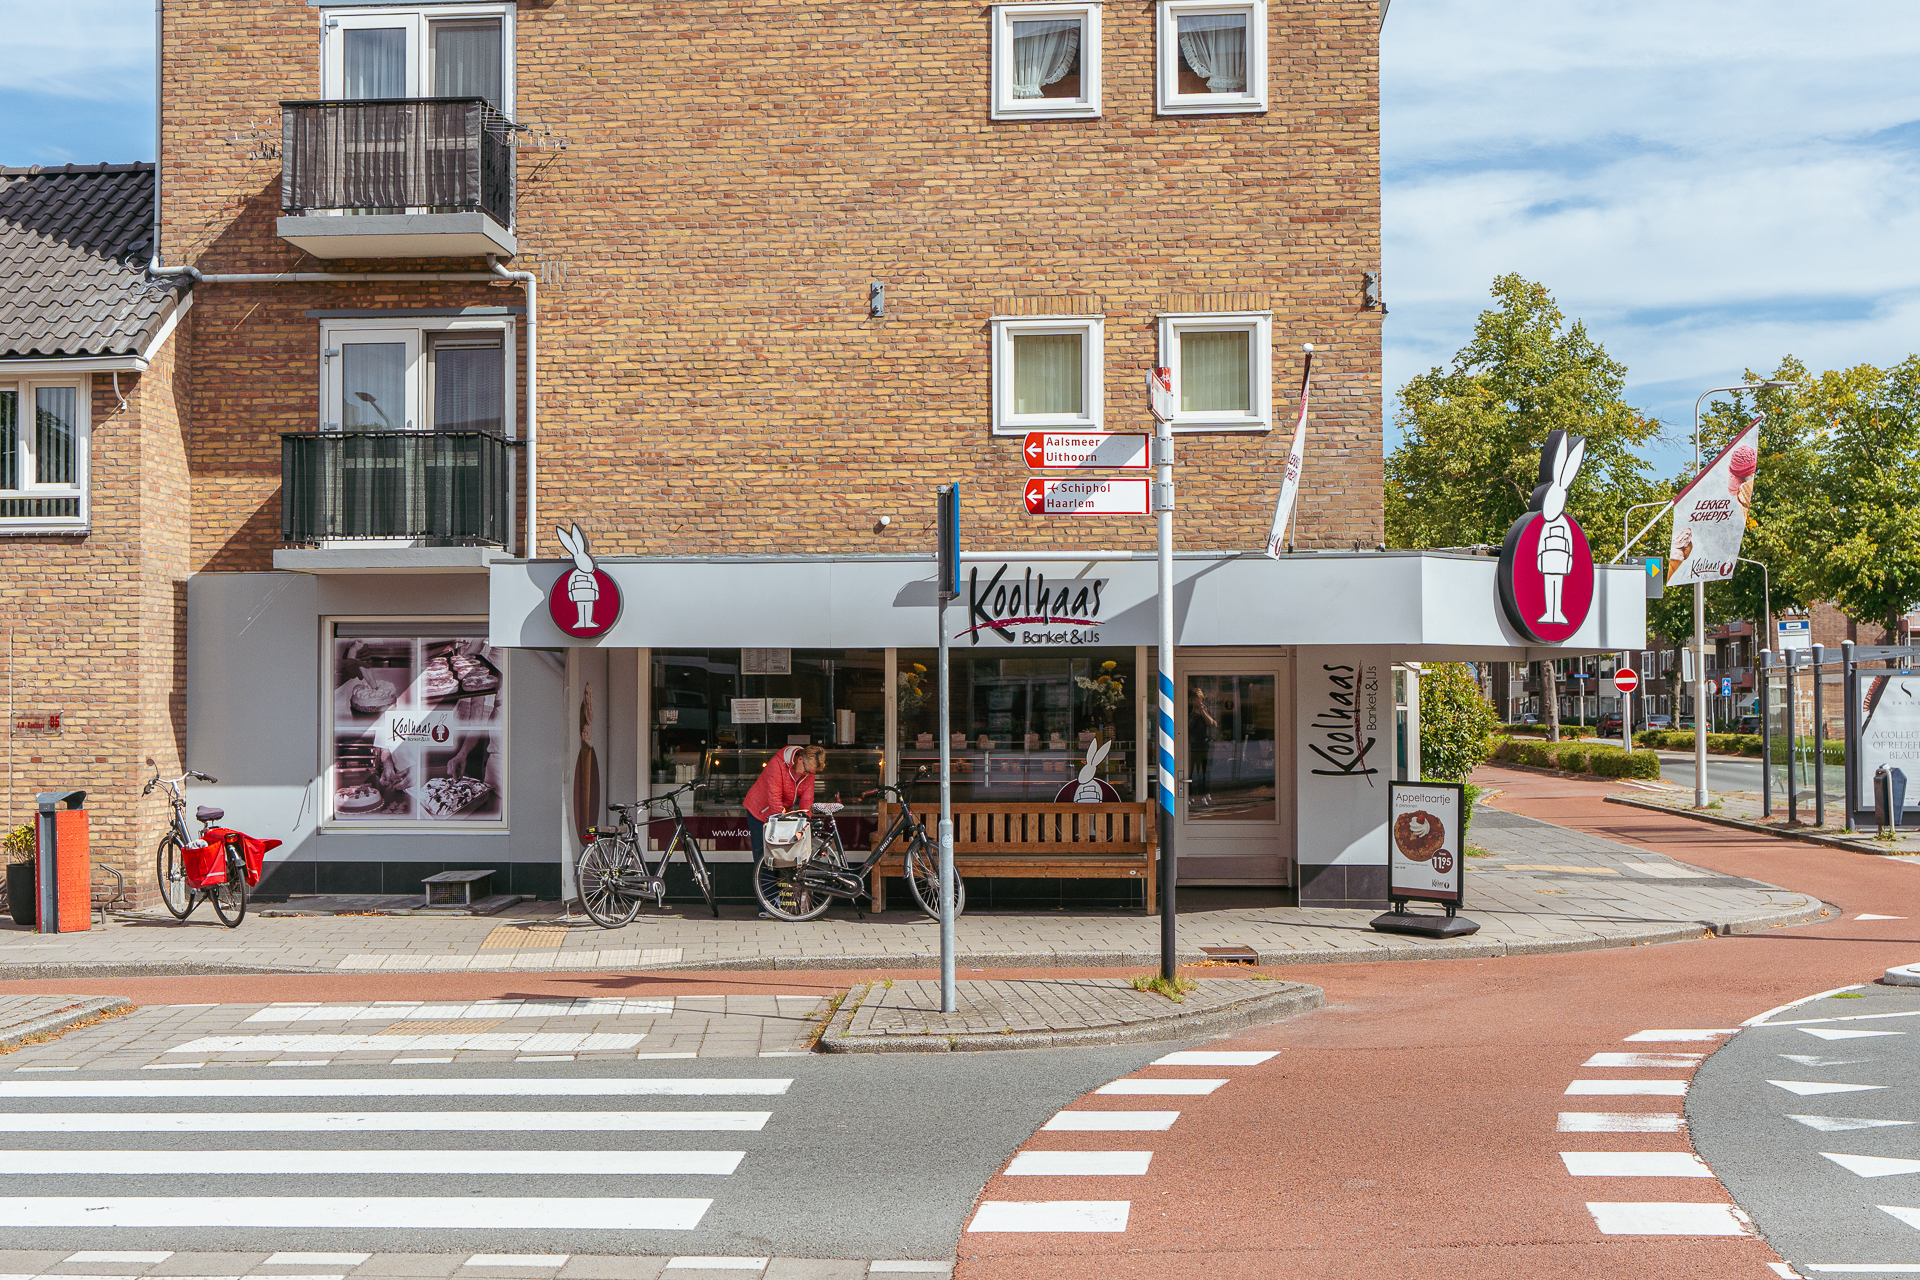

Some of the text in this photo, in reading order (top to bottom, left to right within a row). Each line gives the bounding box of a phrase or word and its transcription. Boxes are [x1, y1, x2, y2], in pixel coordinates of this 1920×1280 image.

[1046, 437, 1100, 447] Aalsmeer
[1046, 452, 1097, 462] Uithoorn
[1061, 483, 1111, 495] Schiphol
[1046, 499, 1095, 508] Haarlem
[1694, 499, 1731, 510] LEKKER
[969, 562, 1102, 646] Koolhaas
[1308, 663, 1379, 777] Koolhaas
[392, 717, 431, 742] Koolhaas
[1873, 741, 1886, 749] OF
[1395, 792, 1451, 806] Appeltaartje
